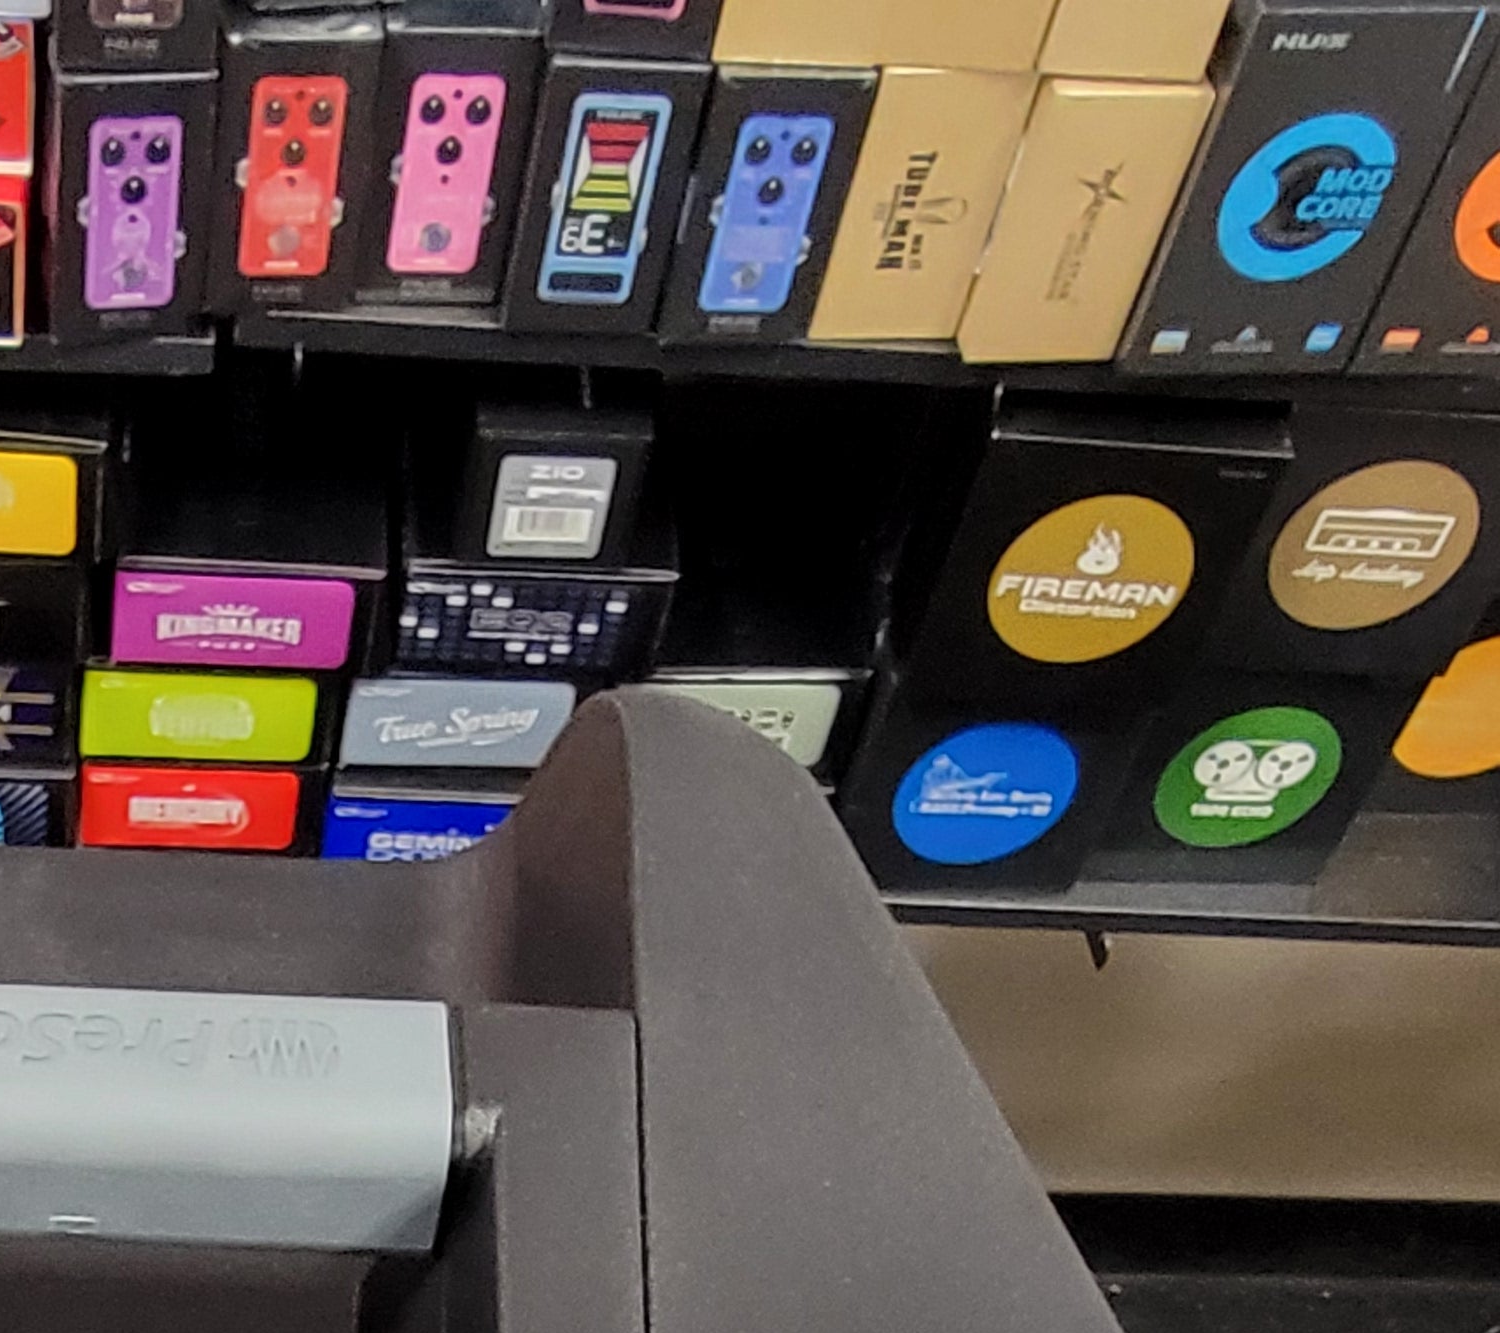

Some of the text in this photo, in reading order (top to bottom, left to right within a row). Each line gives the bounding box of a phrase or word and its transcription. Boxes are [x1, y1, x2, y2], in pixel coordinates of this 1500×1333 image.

[1315, 166, 1393, 194] MOD
[1296, 194, 1384, 221] CORE
[530, 464, 585, 481] ZIO
[996, 574, 1177, 606] FIREMAN
[374, 714, 438, 743] True
